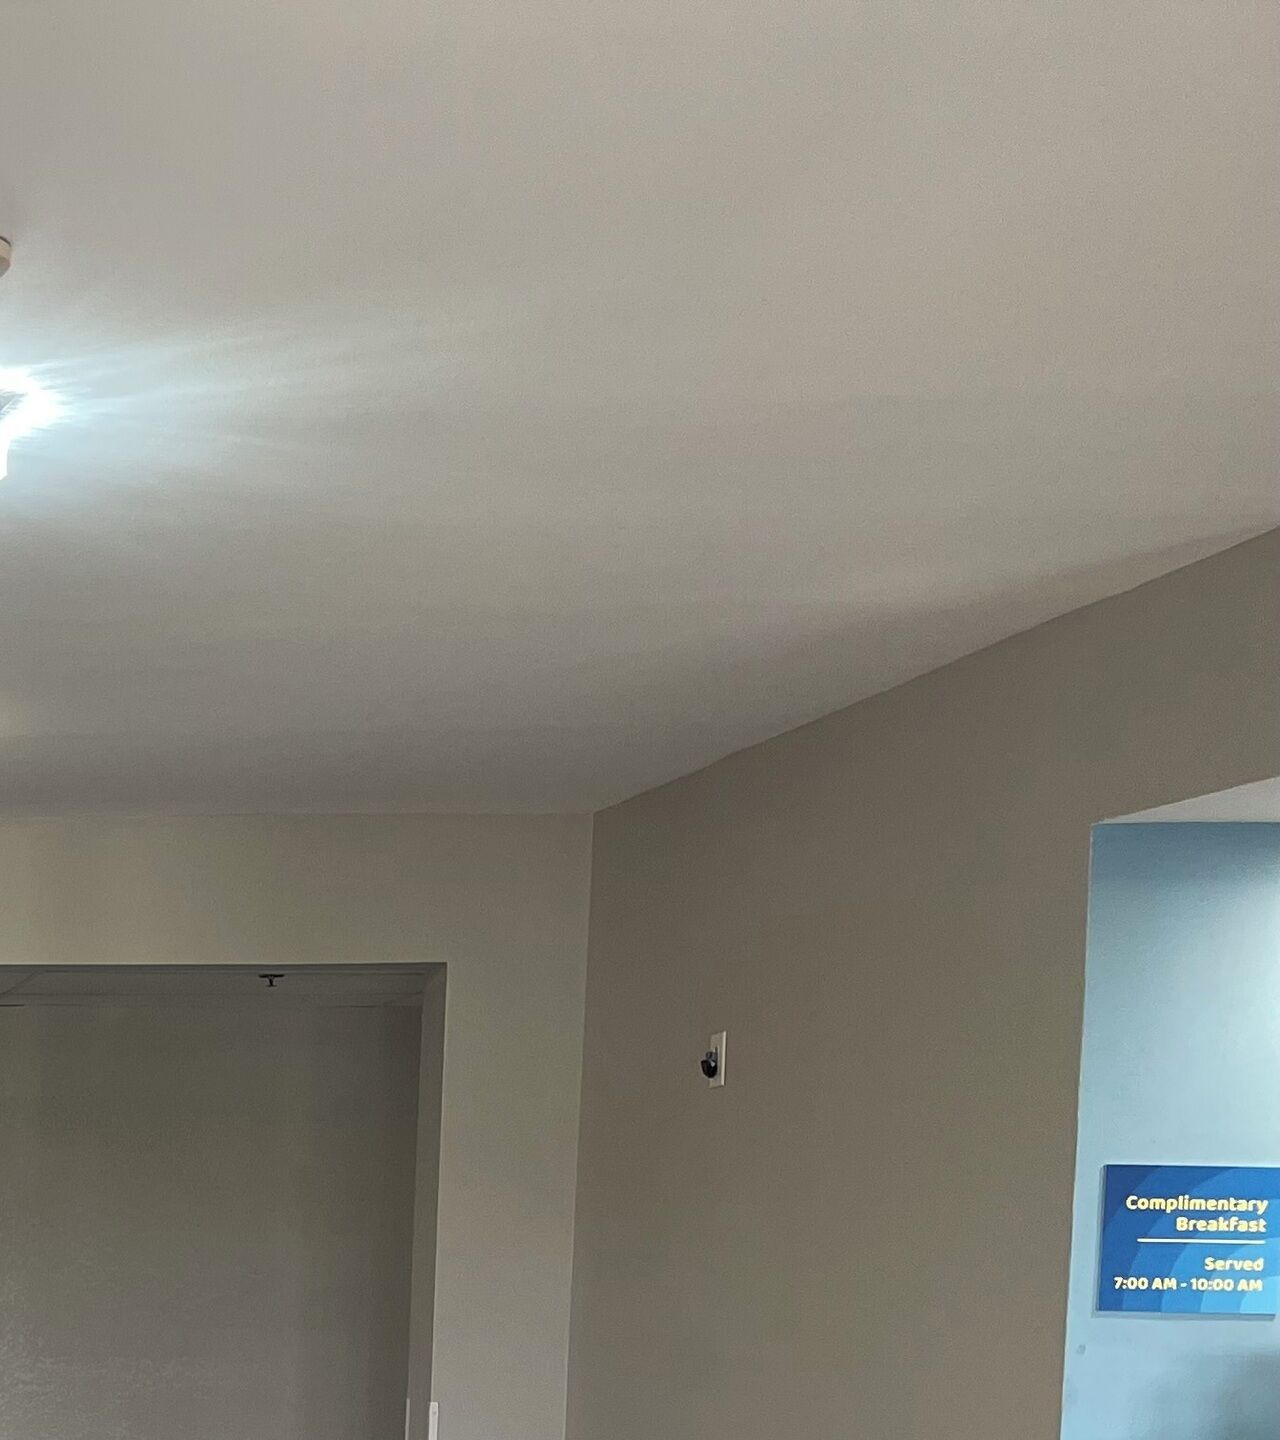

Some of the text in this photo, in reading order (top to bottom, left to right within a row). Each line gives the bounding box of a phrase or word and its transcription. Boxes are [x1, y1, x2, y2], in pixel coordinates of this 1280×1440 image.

[1125, 1195, 1269, 1215] Complimentary
[1175, 1216, 1268, 1233] Breakfast
[1203, 1256, 1265, 1272] Served
[1114, 1276, 1148, 1290] 7:00
[1151, 1278, 1177, 1291] AM
[1190, 1278, 1235, 1292] 10:00
[1237, 1279, 1263, 1292] AM
